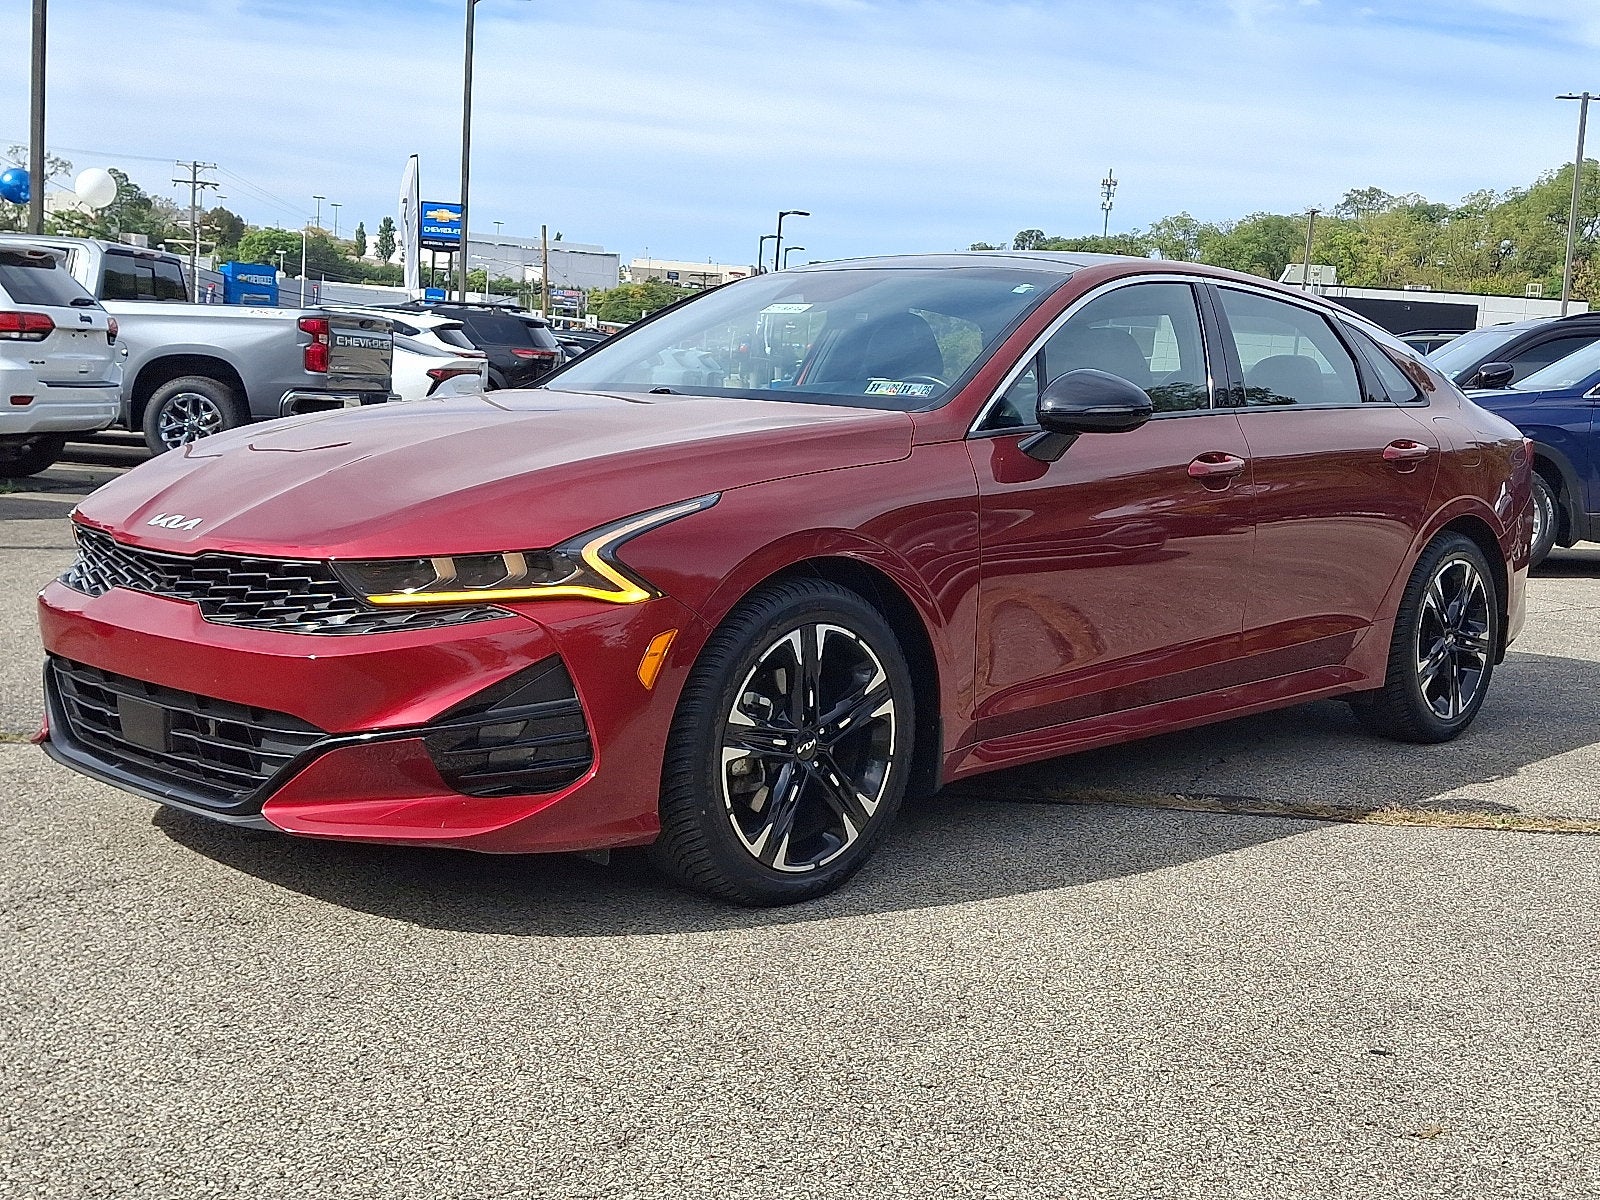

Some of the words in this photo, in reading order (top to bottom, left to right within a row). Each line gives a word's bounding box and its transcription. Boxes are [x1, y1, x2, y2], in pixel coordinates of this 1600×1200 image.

[423, 226, 462, 235] CHEVROLET
[336, 335, 391, 350] CHEVROLET
[147, 512, 203, 531] KIA
